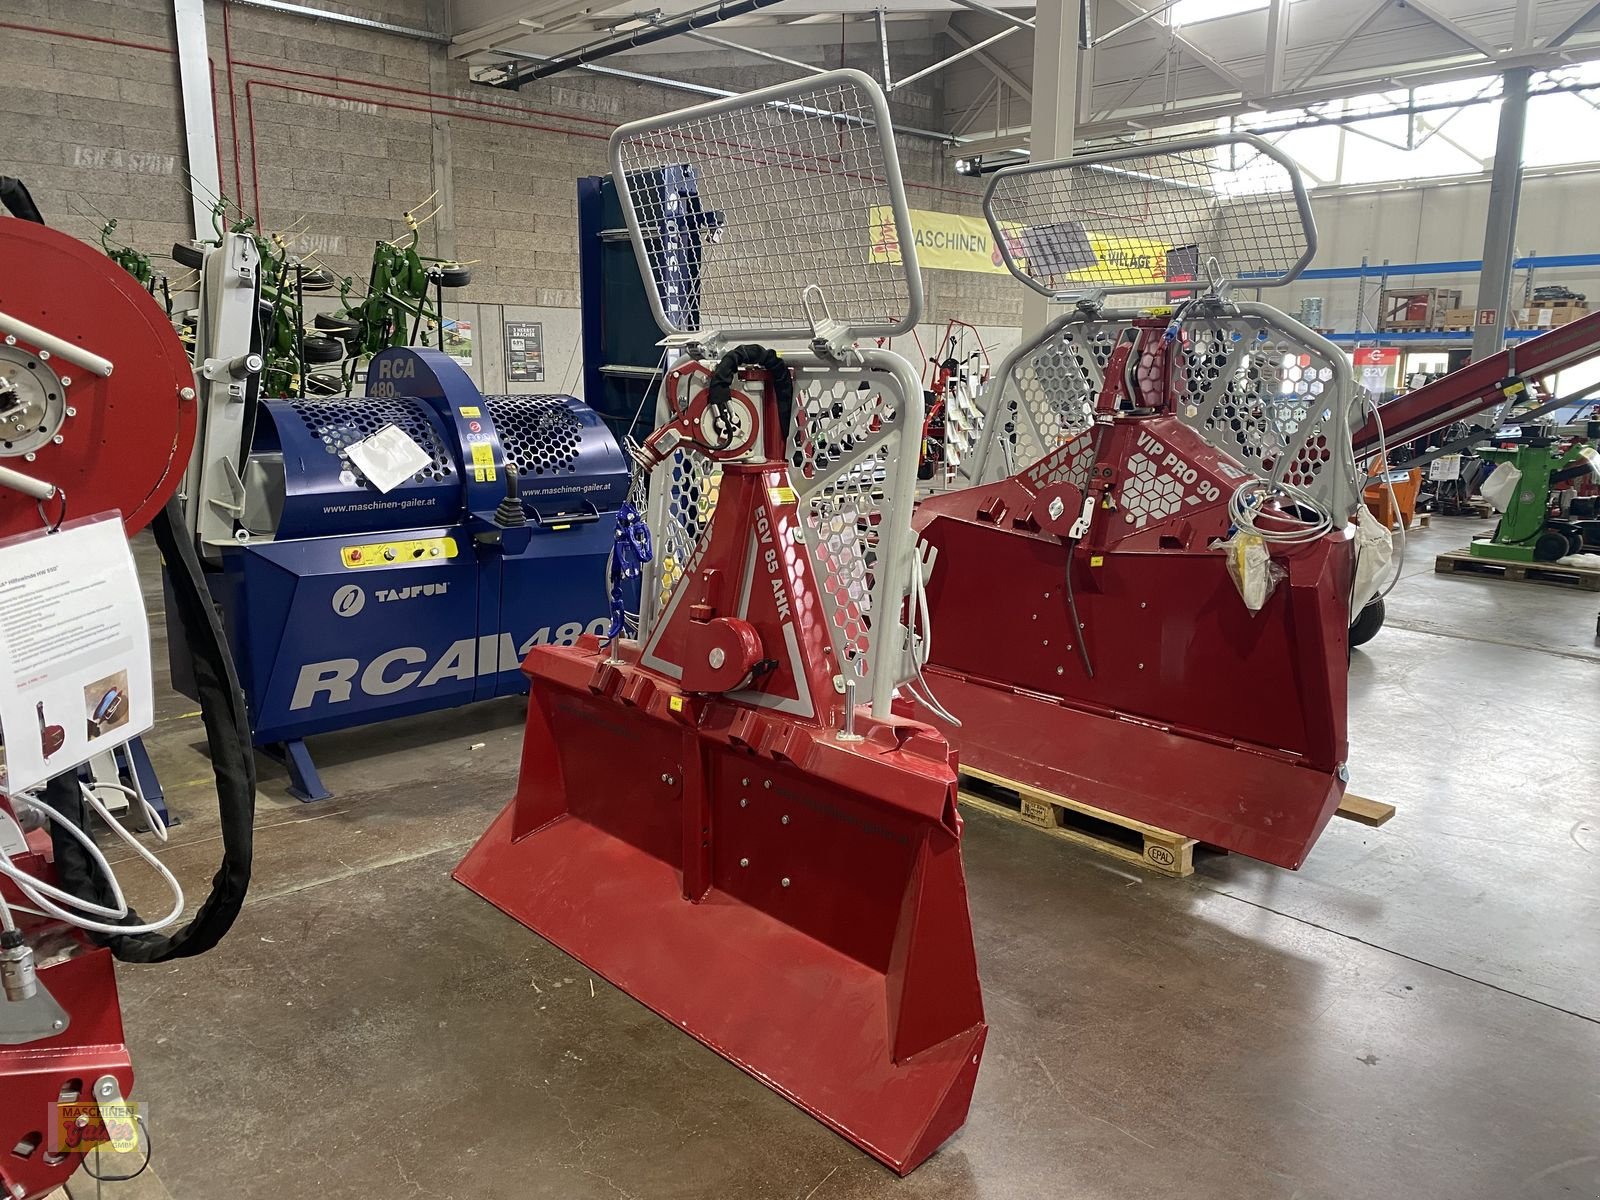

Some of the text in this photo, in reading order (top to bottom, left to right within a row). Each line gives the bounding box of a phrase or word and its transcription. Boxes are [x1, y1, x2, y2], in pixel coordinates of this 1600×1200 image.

[912, 228, 987, 253] ASCHINEN
[379, 358, 415, 379] RCA
[1363, 367, 1387, 377] 82V
[1027, 431, 1093, 482] TAJFUN
[1136, 431, 1164, 456] VIP
[1162, 454, 1198, 485] PRO
[1197, 480, 1220, 502] 90
[521, 483, 611, 497] www.maschinen-gailer.at
[323, 497, 436, 514] www.maschinen-gailer.at
[754, 506, 791, 621] EGV 85 AHK
[375, 581, 448, 603] TAJFUN
[289, 632, 526, 711] RCA
[1151, 849, 1171, 864] EPAL
